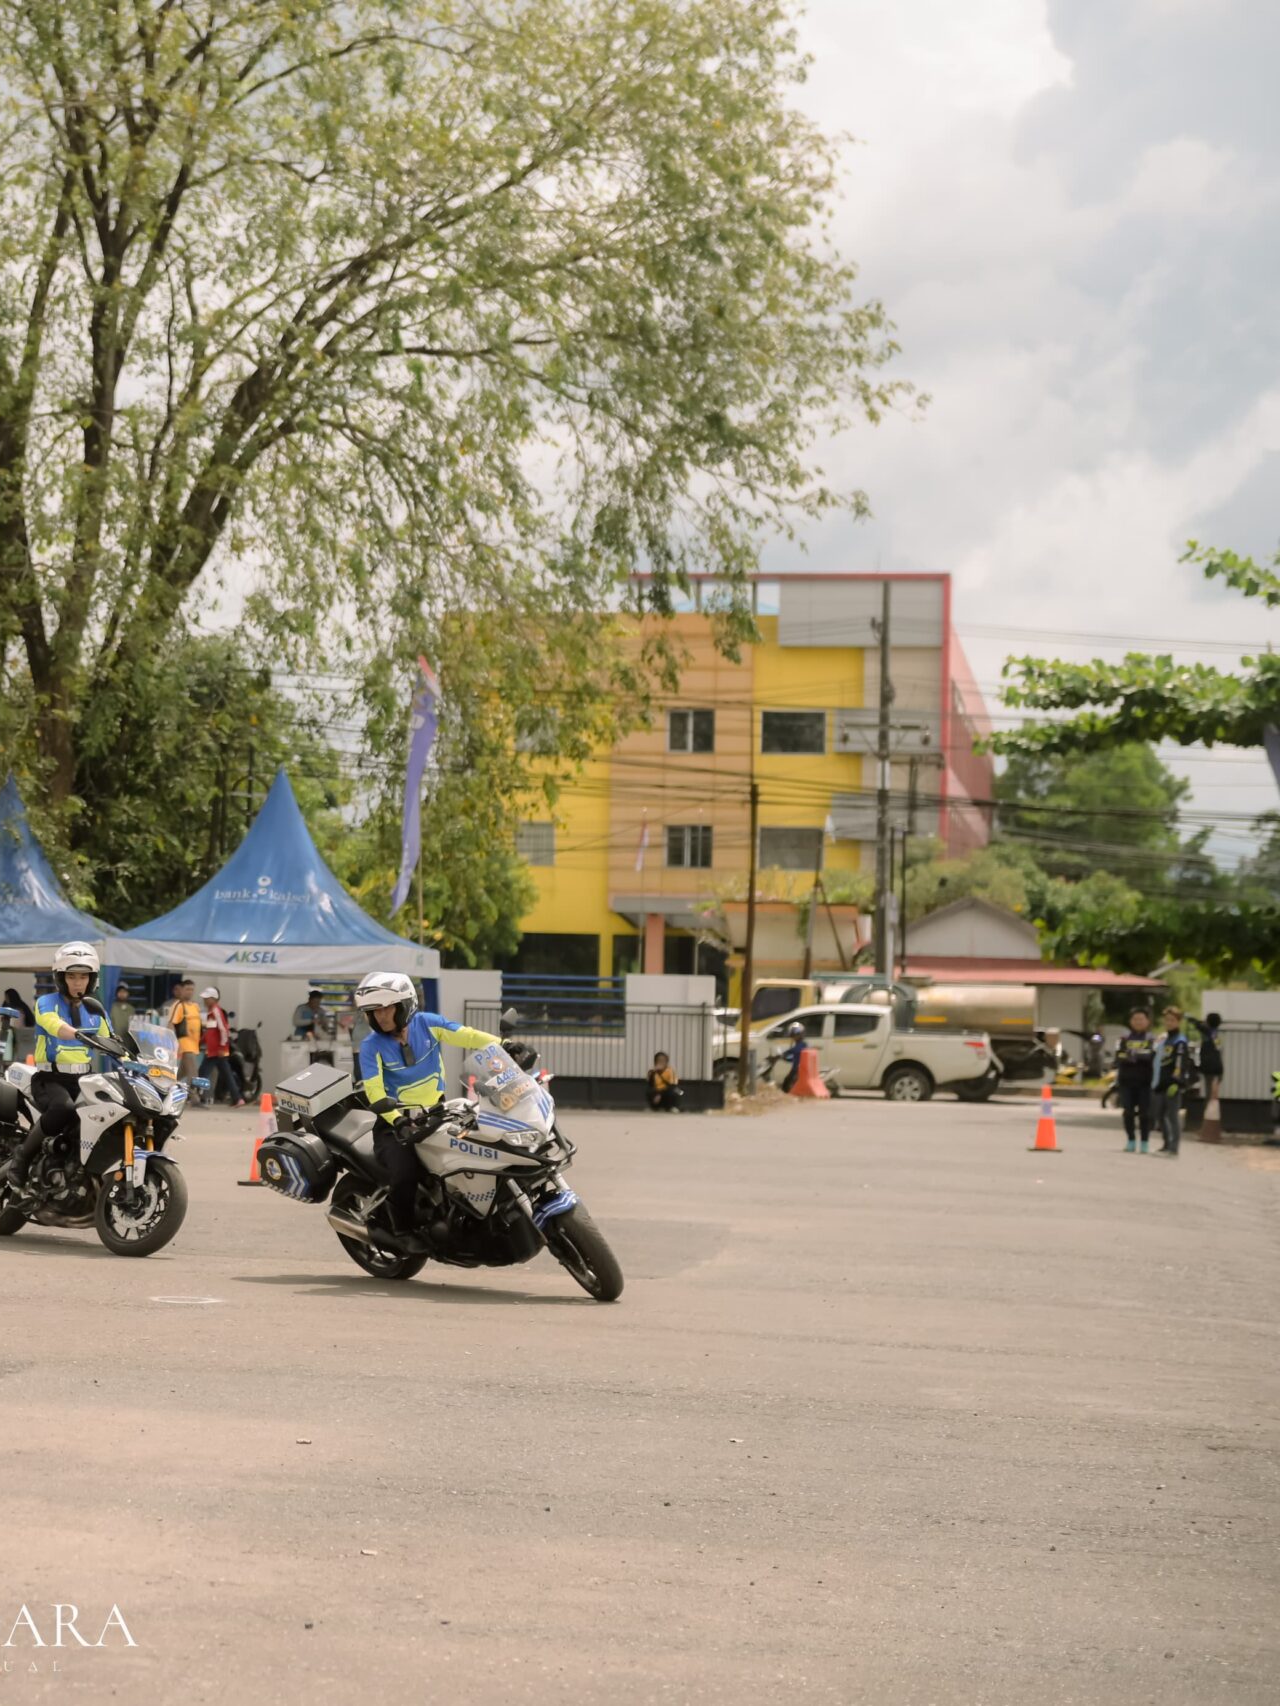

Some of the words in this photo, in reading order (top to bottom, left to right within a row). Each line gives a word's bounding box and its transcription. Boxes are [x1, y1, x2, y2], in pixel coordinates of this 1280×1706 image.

[224, 950, 278, 964] AKSEL
[281, 1098, 309, 1114] POLISI
[450, 1137, 498, 1160] POLISI
